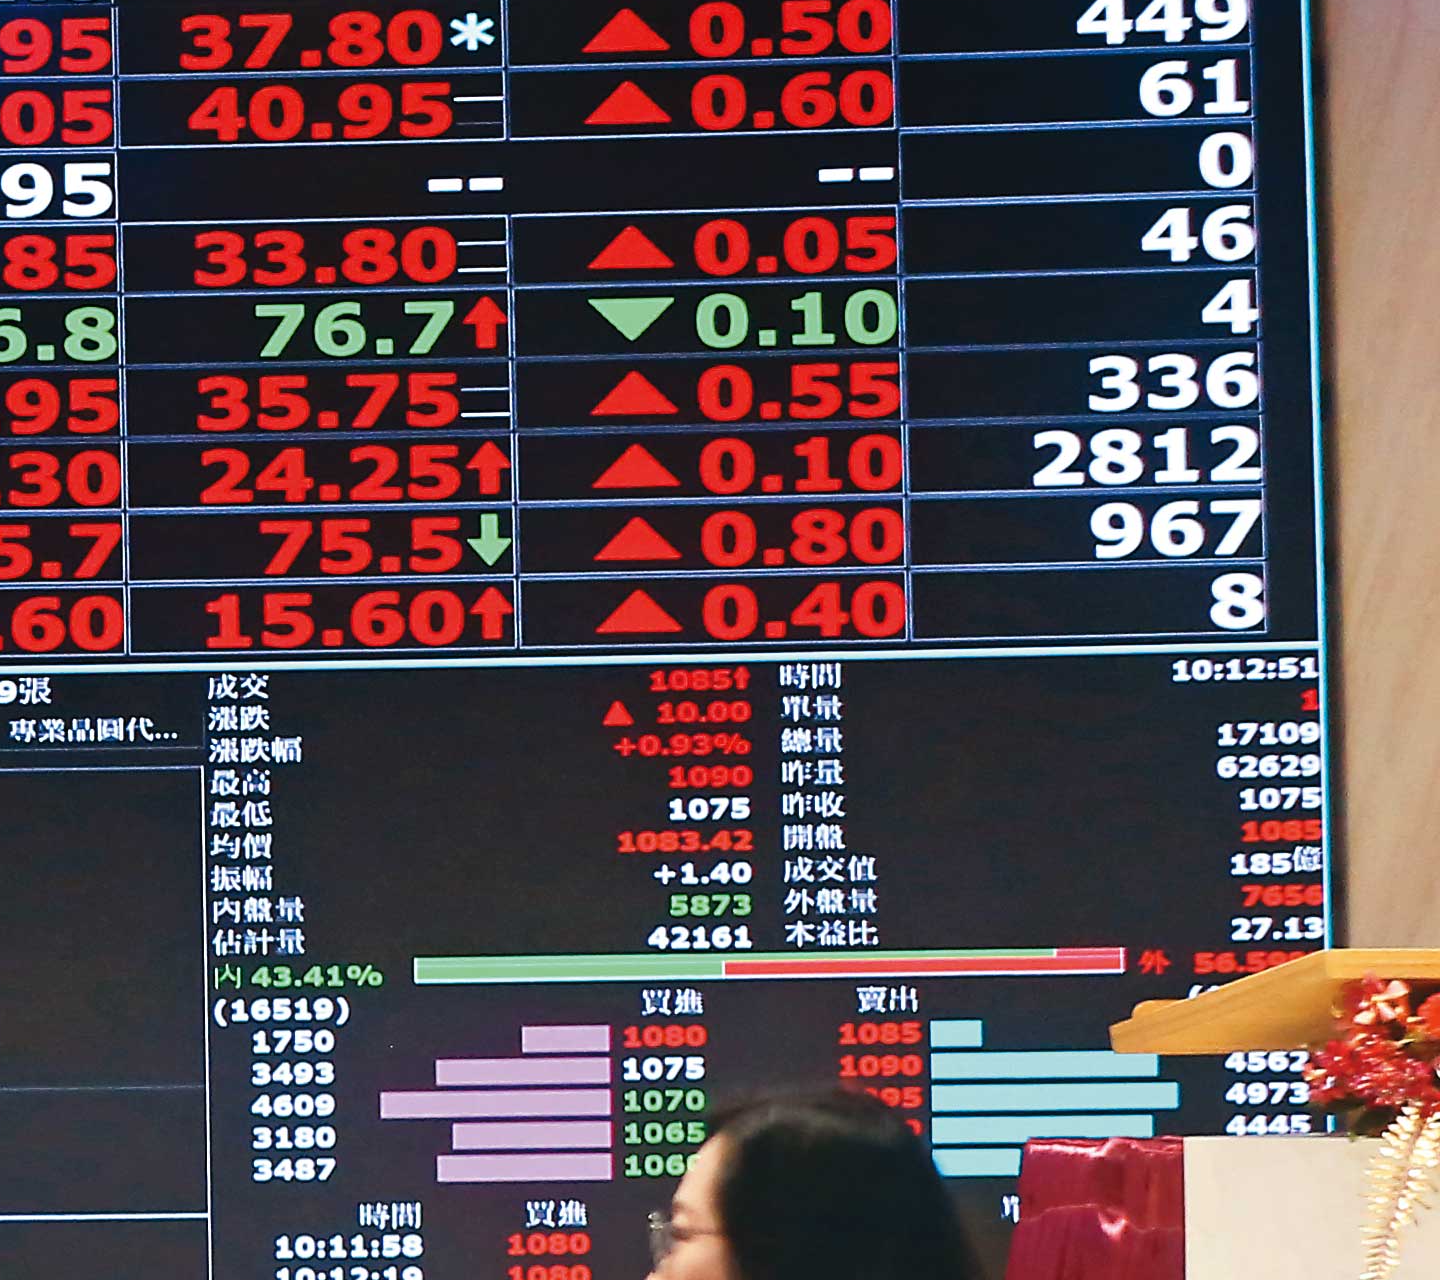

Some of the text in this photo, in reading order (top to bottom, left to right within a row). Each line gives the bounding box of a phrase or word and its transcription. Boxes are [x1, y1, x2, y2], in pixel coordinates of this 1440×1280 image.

[189, 82, 452, 141] 40.95
[692, 71, 894, 130] 0.60
[1140, 60, 1247, 115] 61
[194, 227, 456, 286] 33.80
[694, 217, 897, 275] 0.05
[1142, 206, 1255, 261] 46
[256, 301, 454, 356] 76.7
[696, 289, 897, 348] 0.10
[1203, 280, 1258, 332] 4
[201, 445, 460, 503] 24.25
[700, 434, 903, 494] 0.10
[1034, 426, 1261, 485] 2812
[650, 658, 1318, 691] 1085 10:12:51
[614, 721, 1321, 756] +0.93% 17109
[669, 765, 753, 788] 1090
[618, 830, 753, 852] 1083.42
[654, 862, 751, 884] +1.40
[670, 894, 751, 916] 5873
[251, 965, 383, 987] 43.41%
[214, 997, 349, 1026] (16519)
[253, 1024, 707, 1053] 1750 1080
[252, 1057, 704, 1085] 3493 1075
[276, 1235, 423, 1259] 10:11:58
